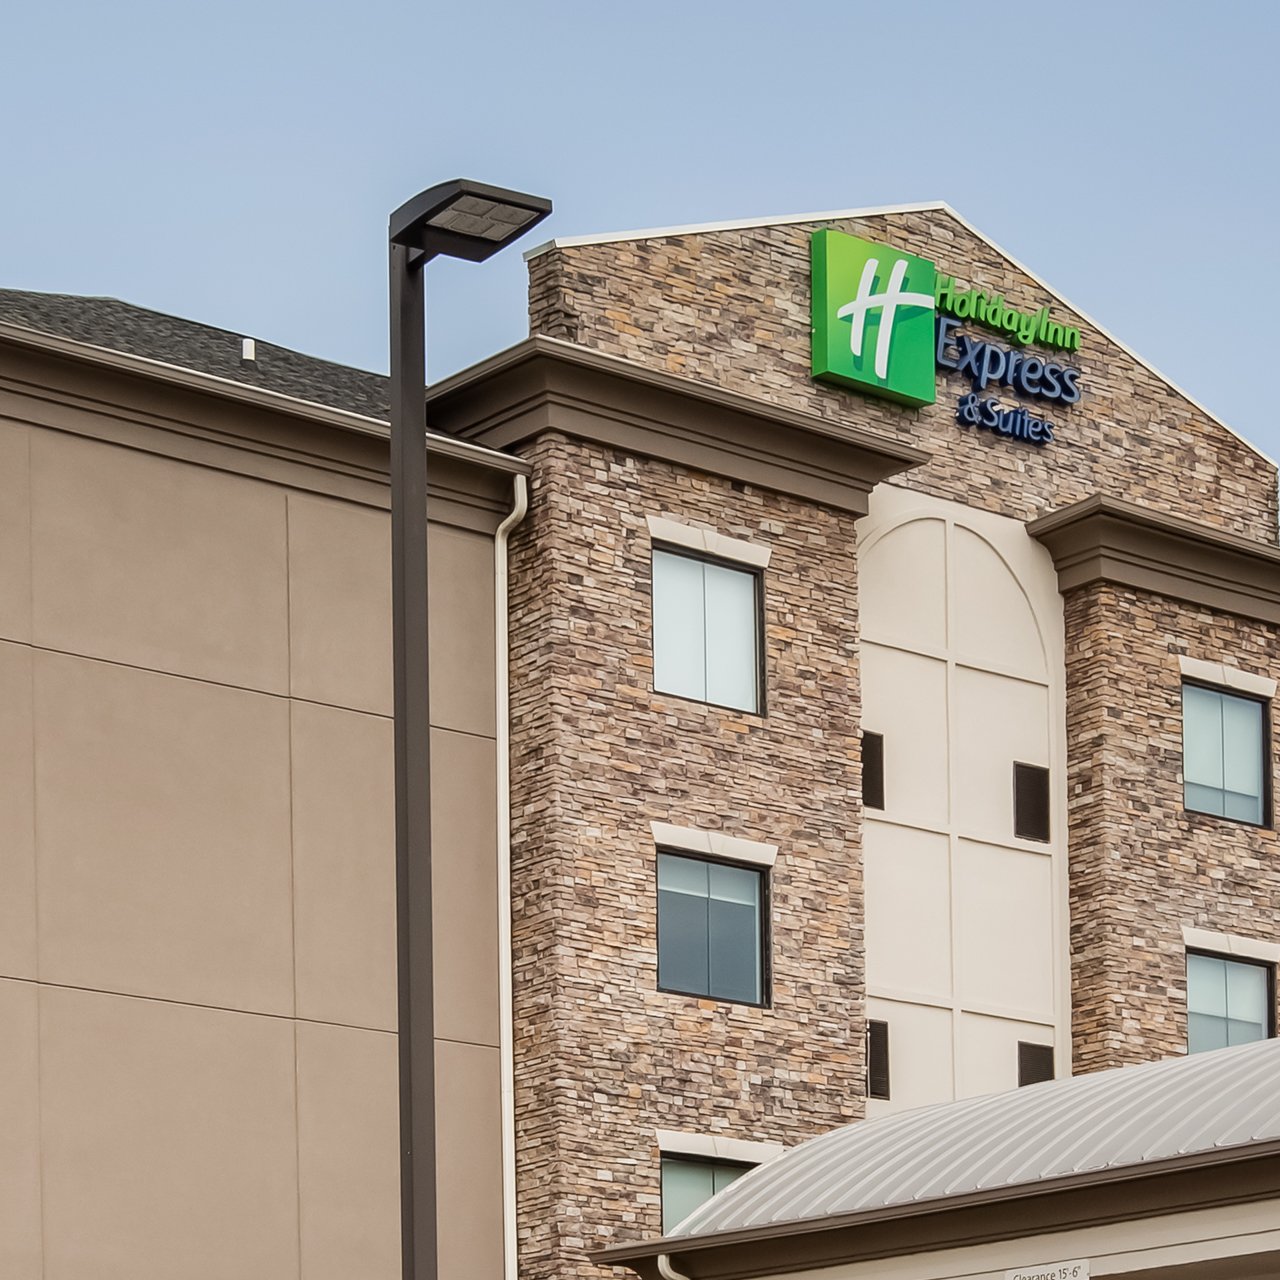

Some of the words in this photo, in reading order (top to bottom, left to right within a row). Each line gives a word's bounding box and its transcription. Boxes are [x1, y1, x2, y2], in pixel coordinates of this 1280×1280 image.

[934, 271, 1037, 346] Holiday
[1038, 306, 1081, 353] Inn
[935, 316, 1081, 404] Express
[959, 392, 981, 425] &
[982, 396, 1056, 443] Suites
